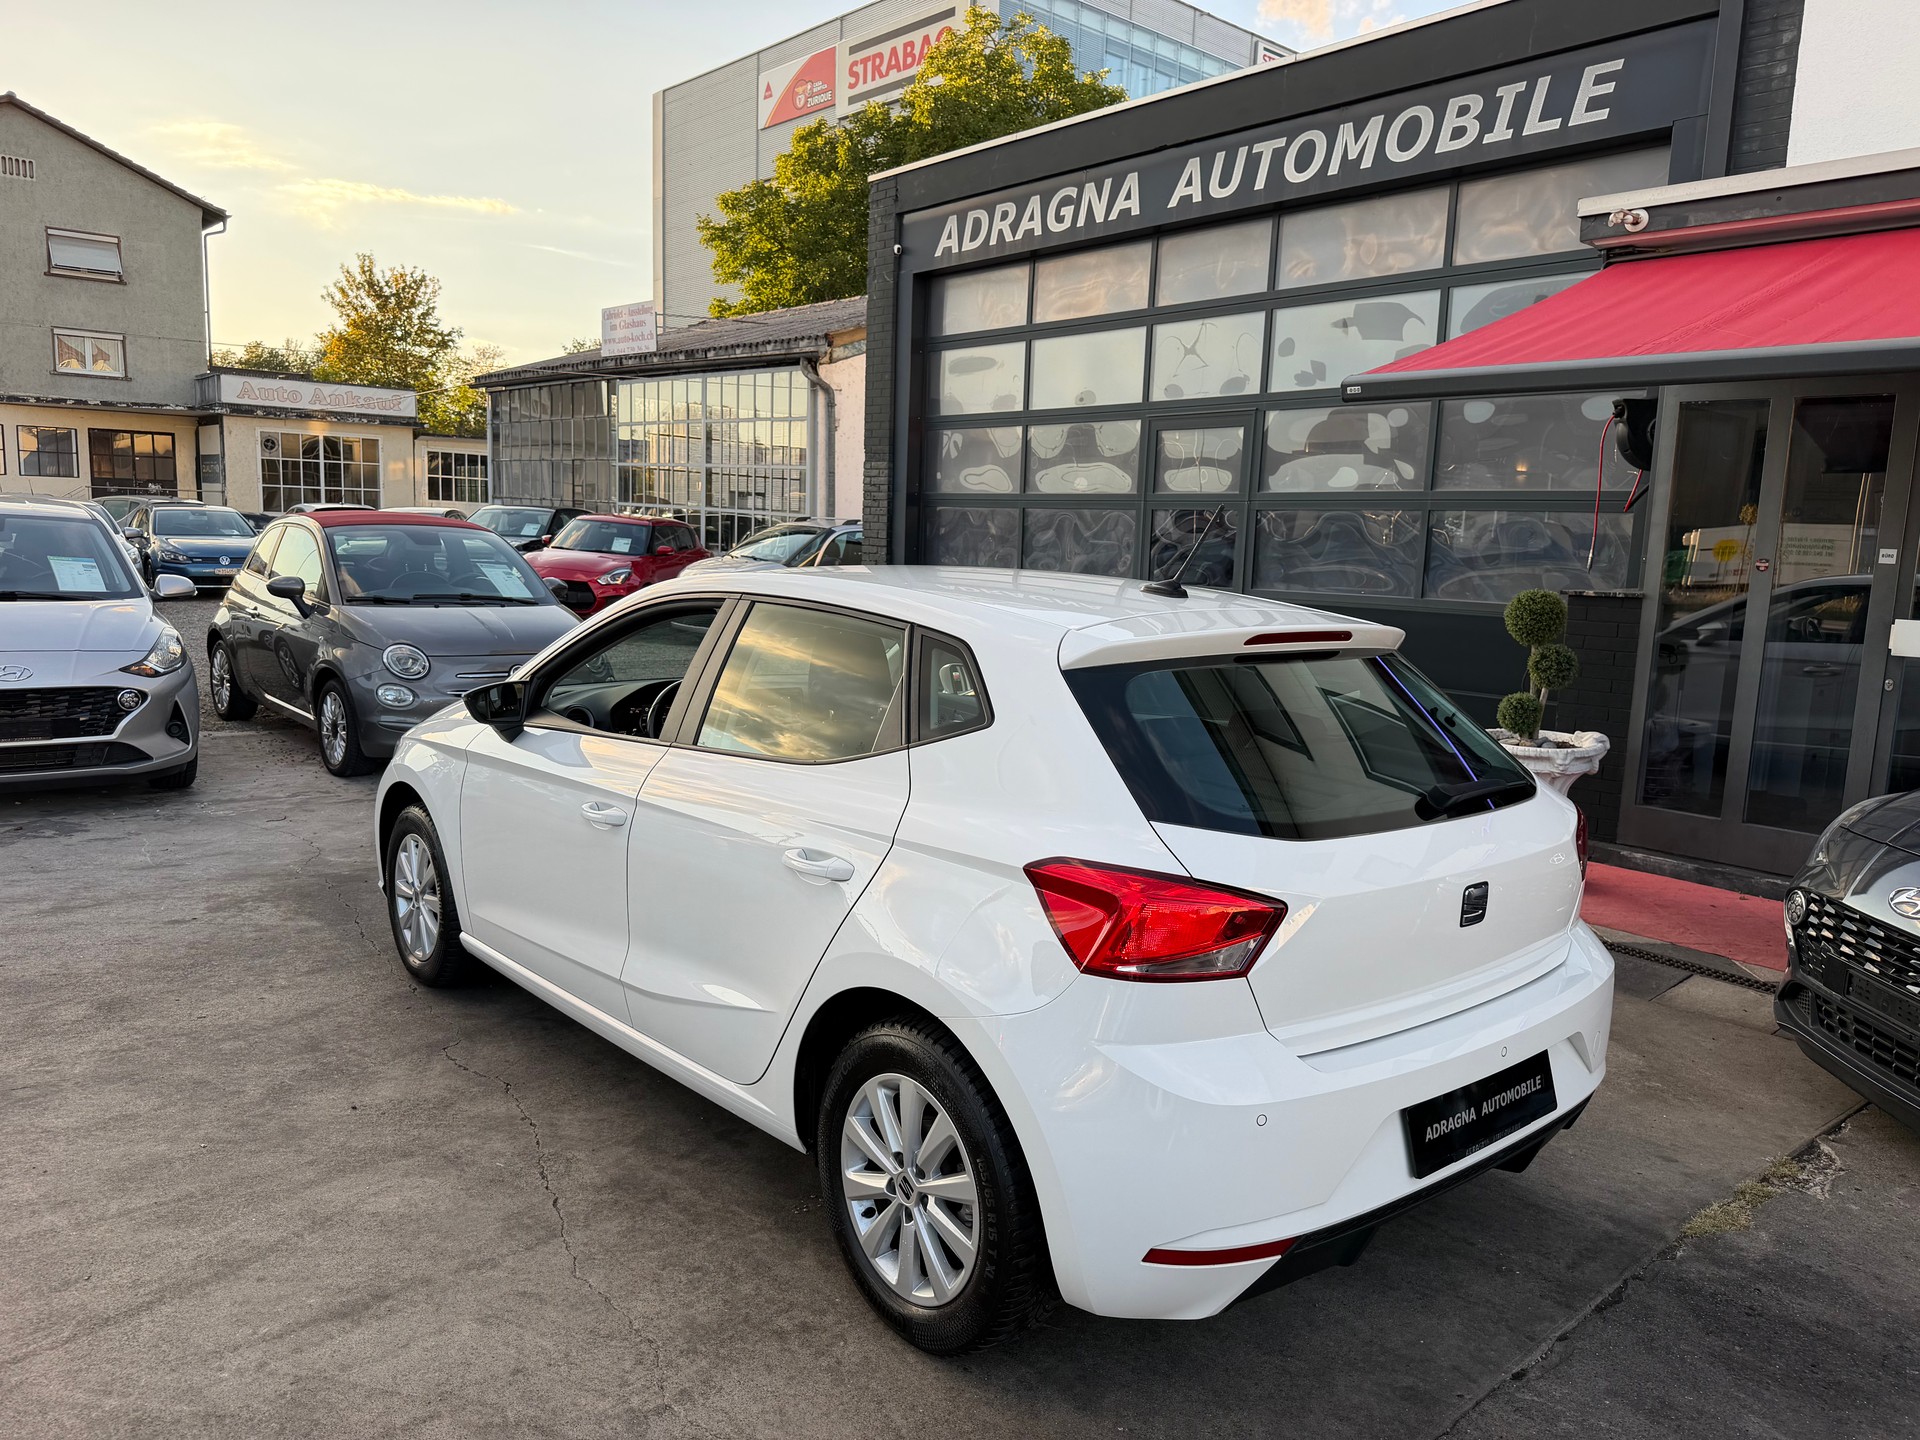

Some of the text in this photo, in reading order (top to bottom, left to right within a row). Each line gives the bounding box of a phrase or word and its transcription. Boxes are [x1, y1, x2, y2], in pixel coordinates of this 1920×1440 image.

[848, 25, 952, 89] STRABA
[807, 90, 832, 107] ZURIQUE
[934, 59, 1626, 257] ADRAGNA AUTOMOBILE
[603, 330, 655, 345] www.auto-koch.ch
[619, 318, 647, 330] Glashaus
[237, 381, 402, 411] Auto Ankauf
[1425, 1107, 1476, 1143] ADRAGNA
[1481, 1075, 1542, 1117] AUTOMOBILE
